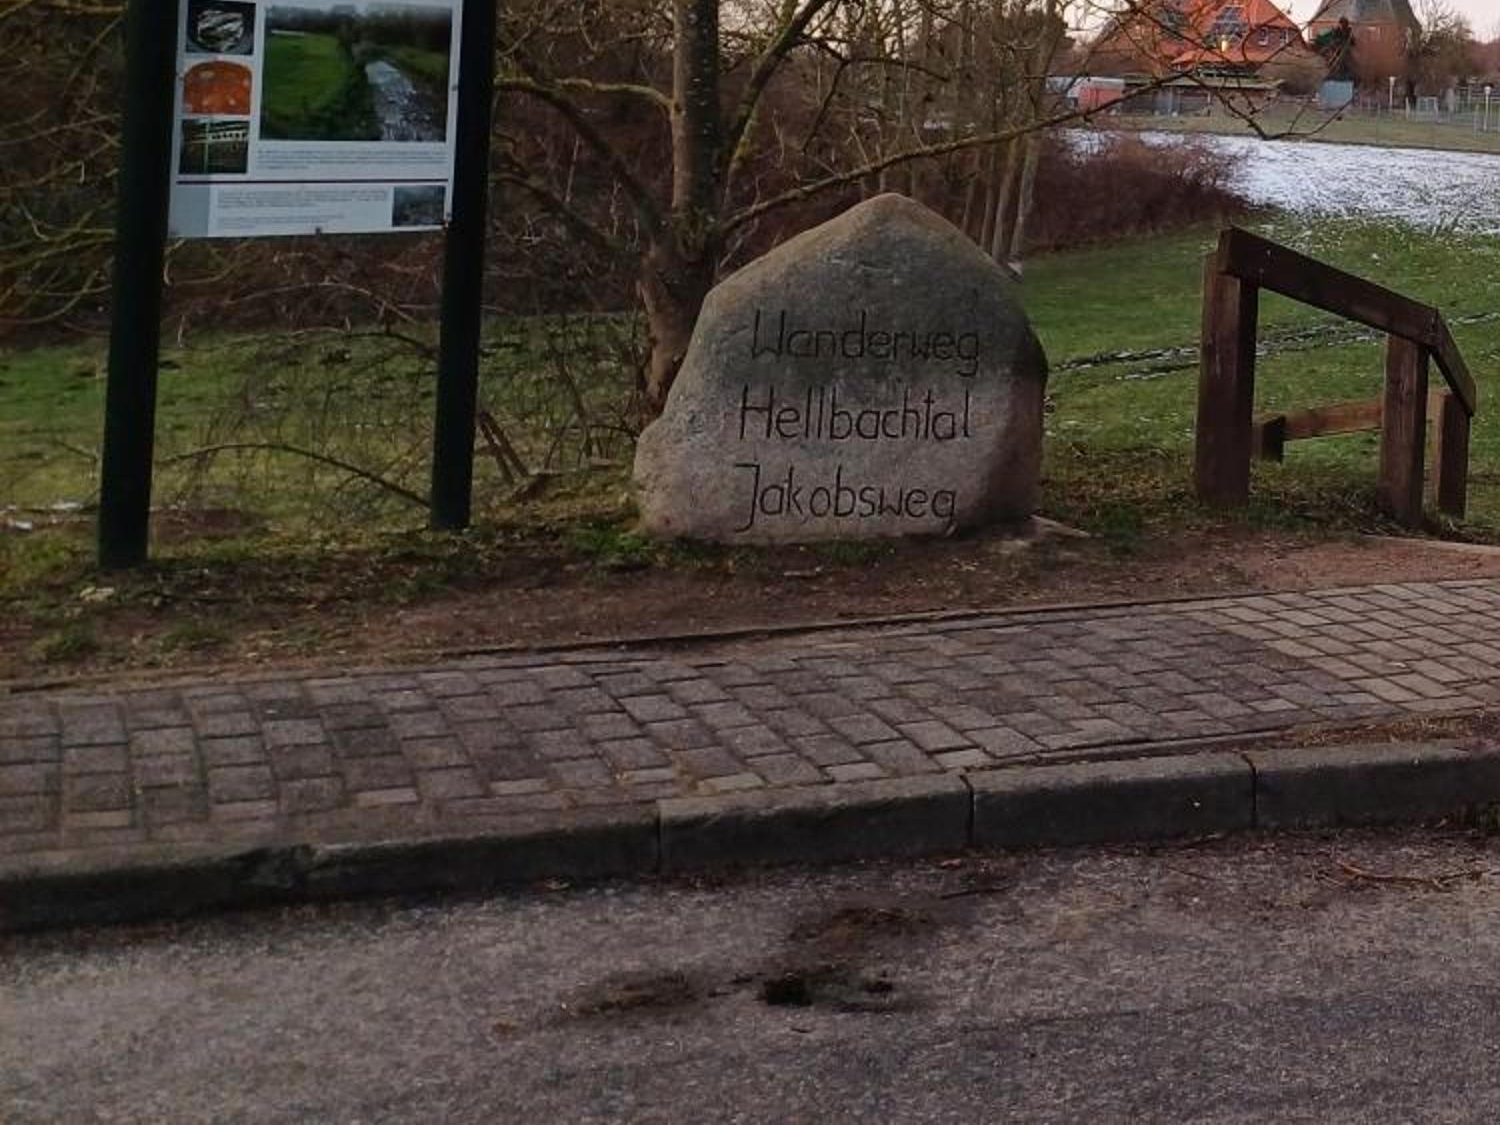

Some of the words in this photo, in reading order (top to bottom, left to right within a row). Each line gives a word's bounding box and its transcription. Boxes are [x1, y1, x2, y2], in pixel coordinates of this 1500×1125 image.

[751, 309, 980, 376] Wanderweg
[739, 383, 971, 441] Hellbachtal
[734, 462, 957, 533] Jakobsweg
